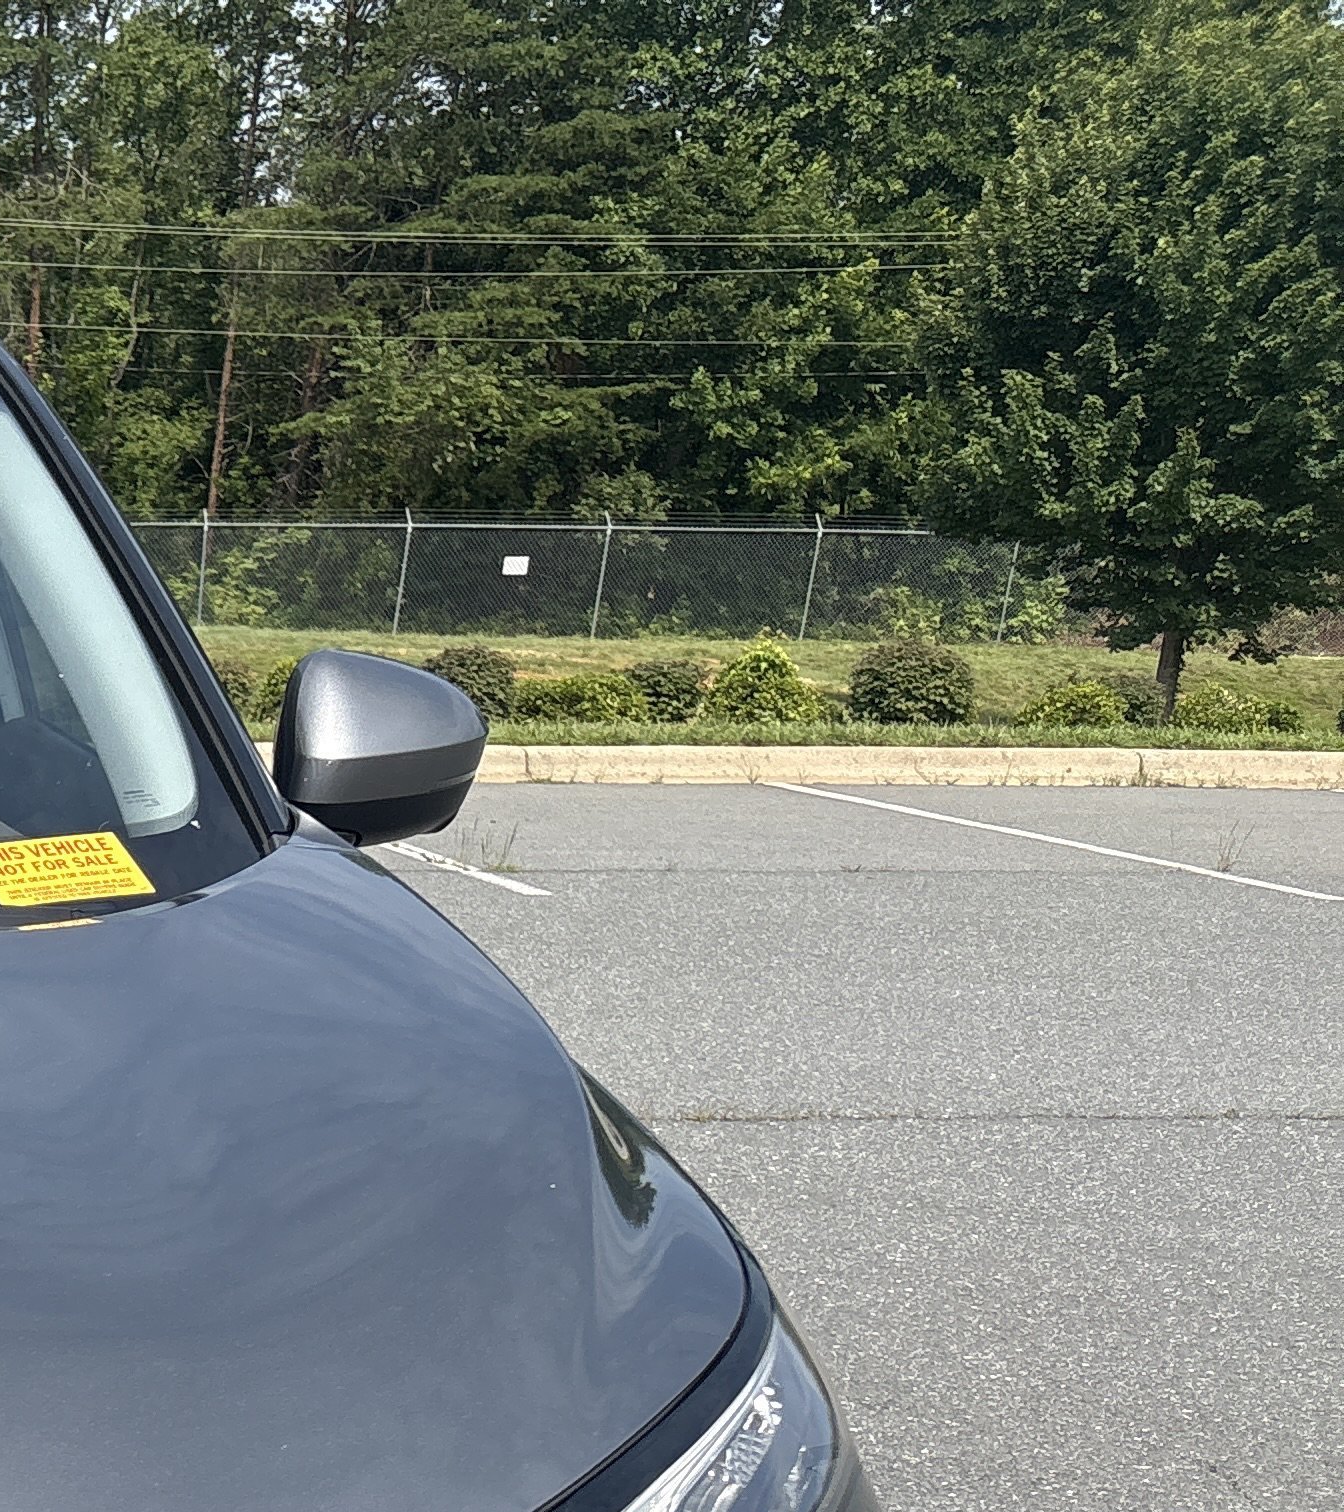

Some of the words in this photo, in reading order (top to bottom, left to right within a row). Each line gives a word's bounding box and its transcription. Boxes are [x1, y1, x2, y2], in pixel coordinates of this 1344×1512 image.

[23, 837, 113, 857] VEHICLE
[31, 859, 70, 872] FOR
[72, 854, 118, 867] SALE
[112, 866, 132, 874] DATE
